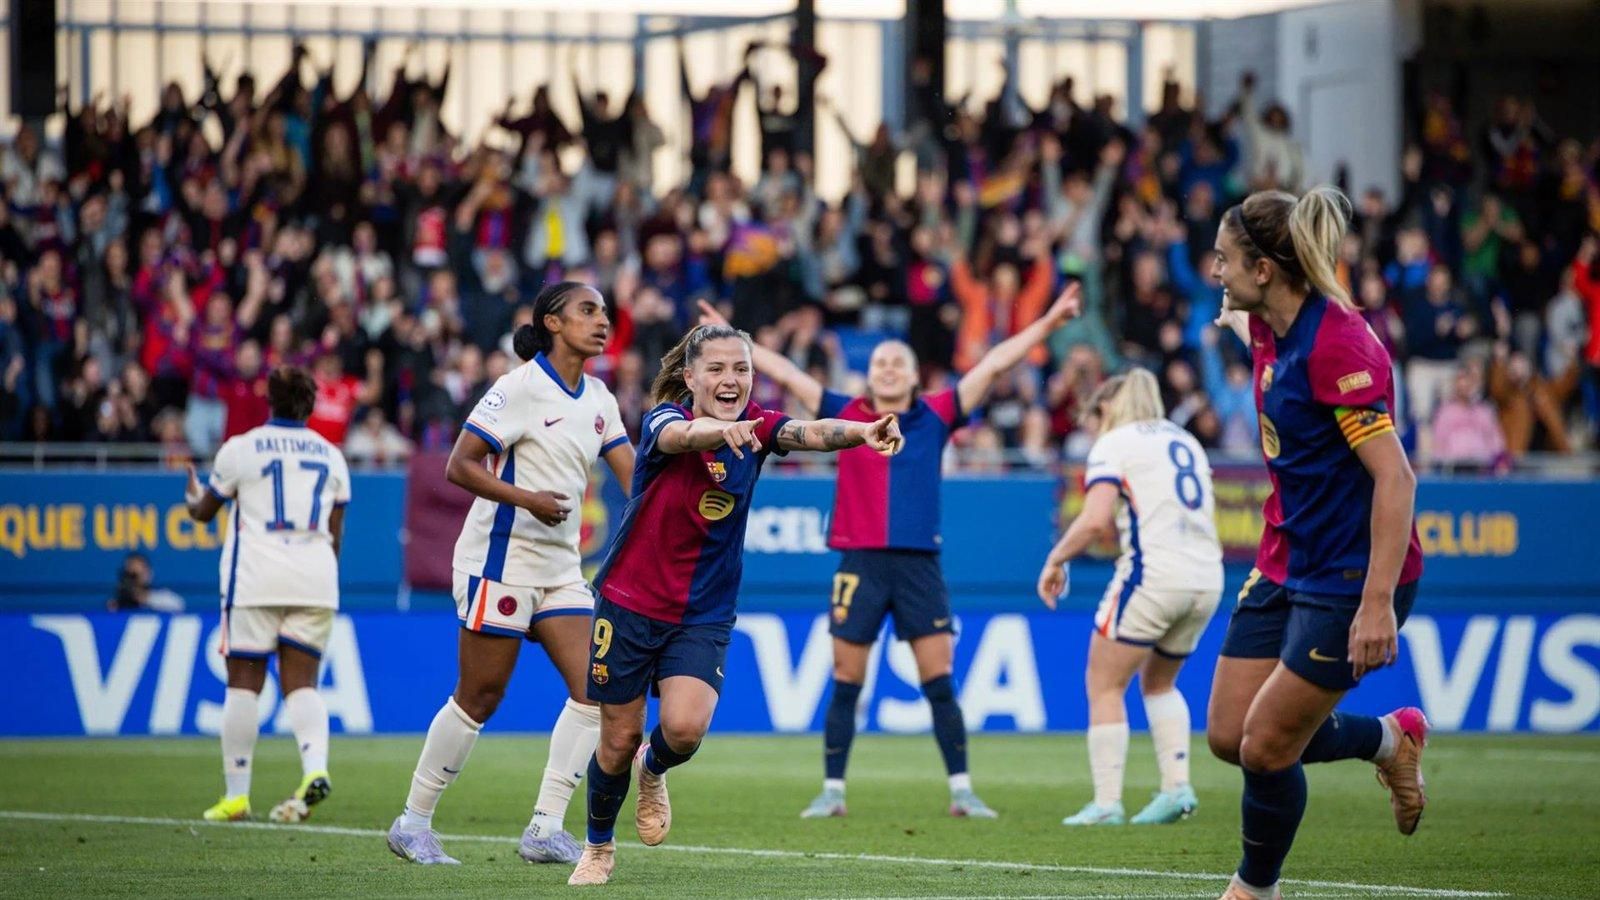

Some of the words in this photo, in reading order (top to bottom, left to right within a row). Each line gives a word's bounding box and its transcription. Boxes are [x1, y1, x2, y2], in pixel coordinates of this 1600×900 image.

[262, 459, 328, 530] 17
[1169, 440, 1203, 511] 8
[0, 503, 86, 558] QUE
[93, 503, 157, 550] UN
[1416, 510, 1518, 557] CLUB
[832, 571, 860, 606] 17
[594, 618, 614, 659] 9
